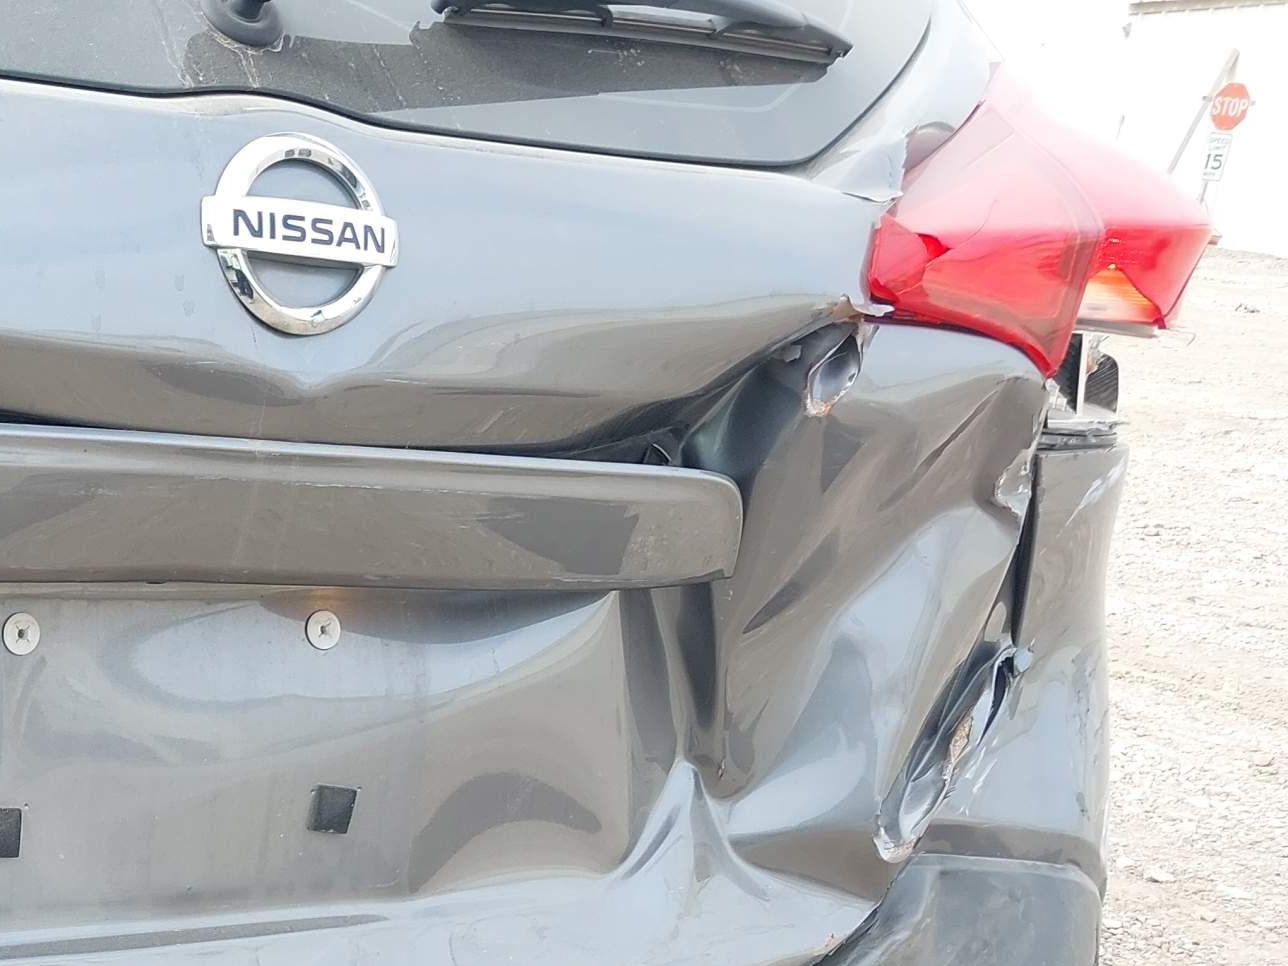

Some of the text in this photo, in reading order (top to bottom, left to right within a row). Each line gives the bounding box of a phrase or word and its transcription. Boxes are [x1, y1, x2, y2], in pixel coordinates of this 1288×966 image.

[1212, 97, 1249, 117] STOP
[1204, 153, 1224, 170] 15
[233, 209, 385, 254] NISSAN
